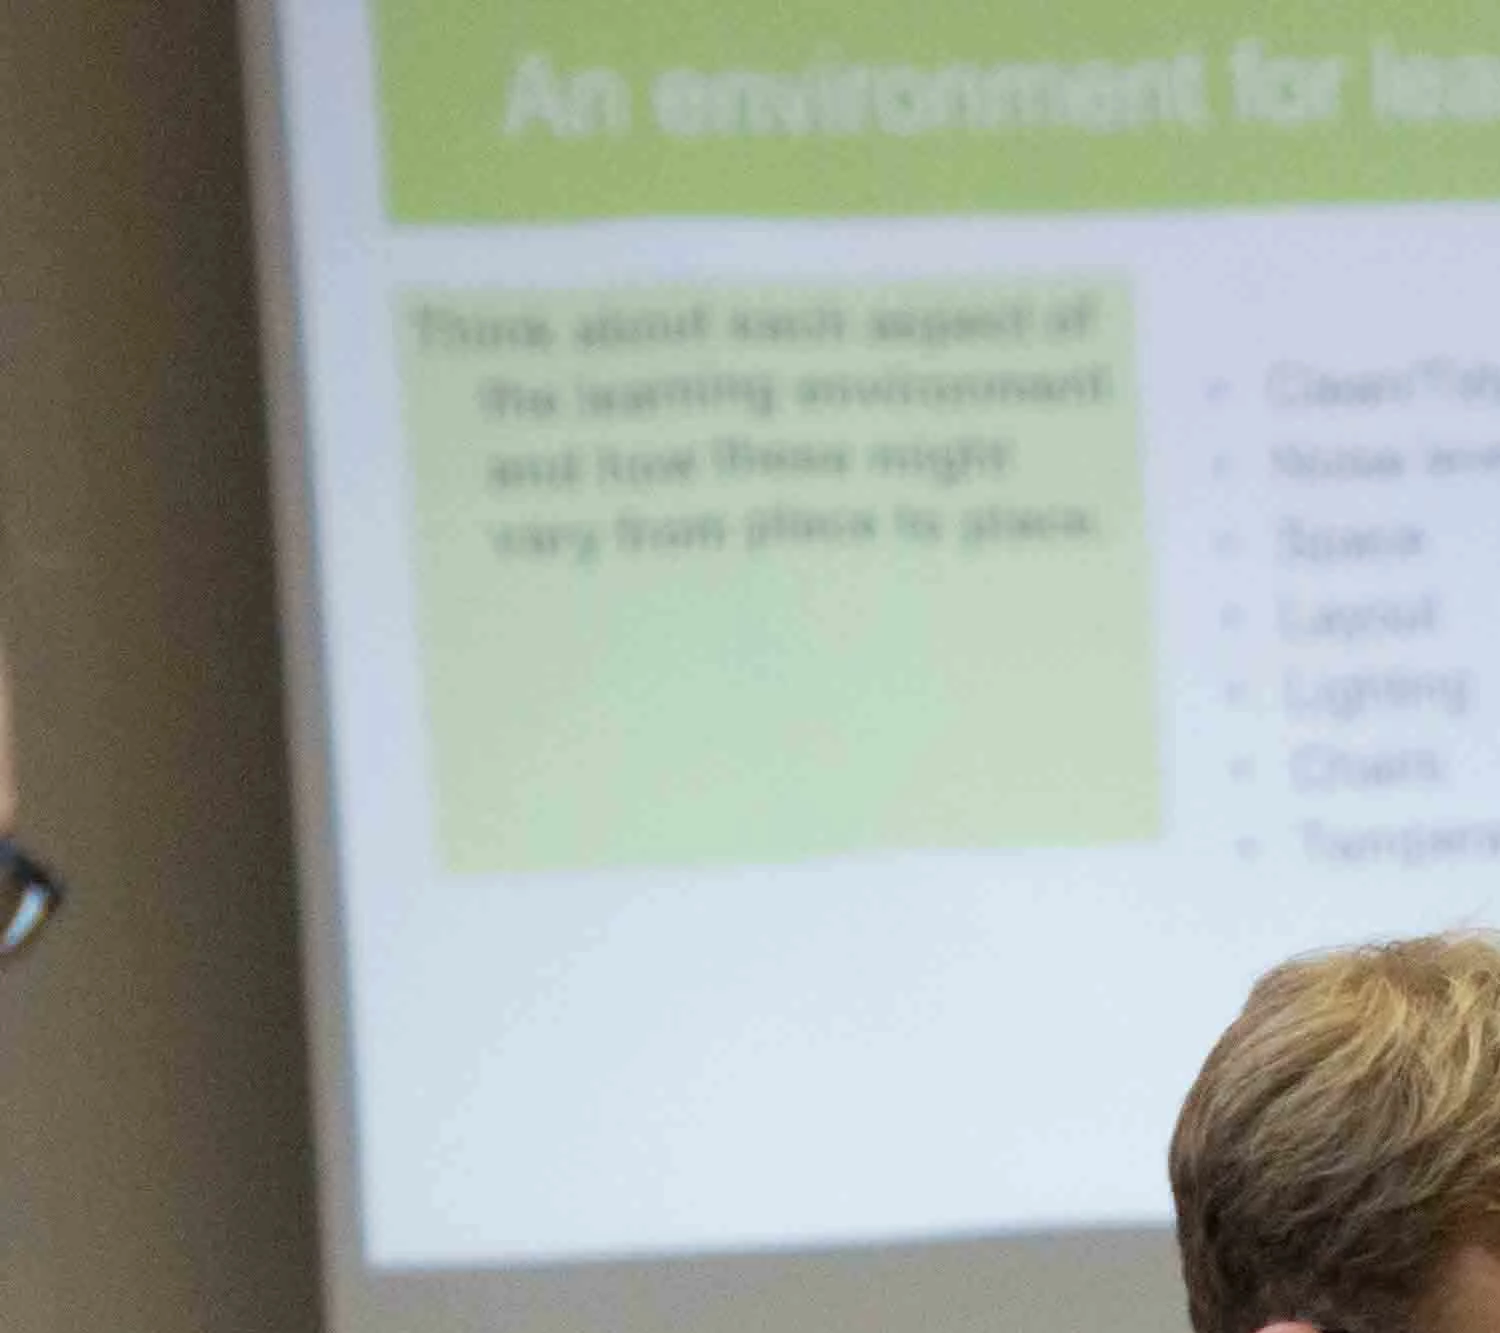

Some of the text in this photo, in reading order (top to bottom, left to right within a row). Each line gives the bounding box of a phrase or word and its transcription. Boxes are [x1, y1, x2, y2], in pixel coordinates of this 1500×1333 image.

[502, 48, 629, 138] An
[654, 46, 1209, 137] environment
[1231, 37, 1346, 127] for
[577, 373, 775, 419] learning
[795, 365, 1112, 412] environment
